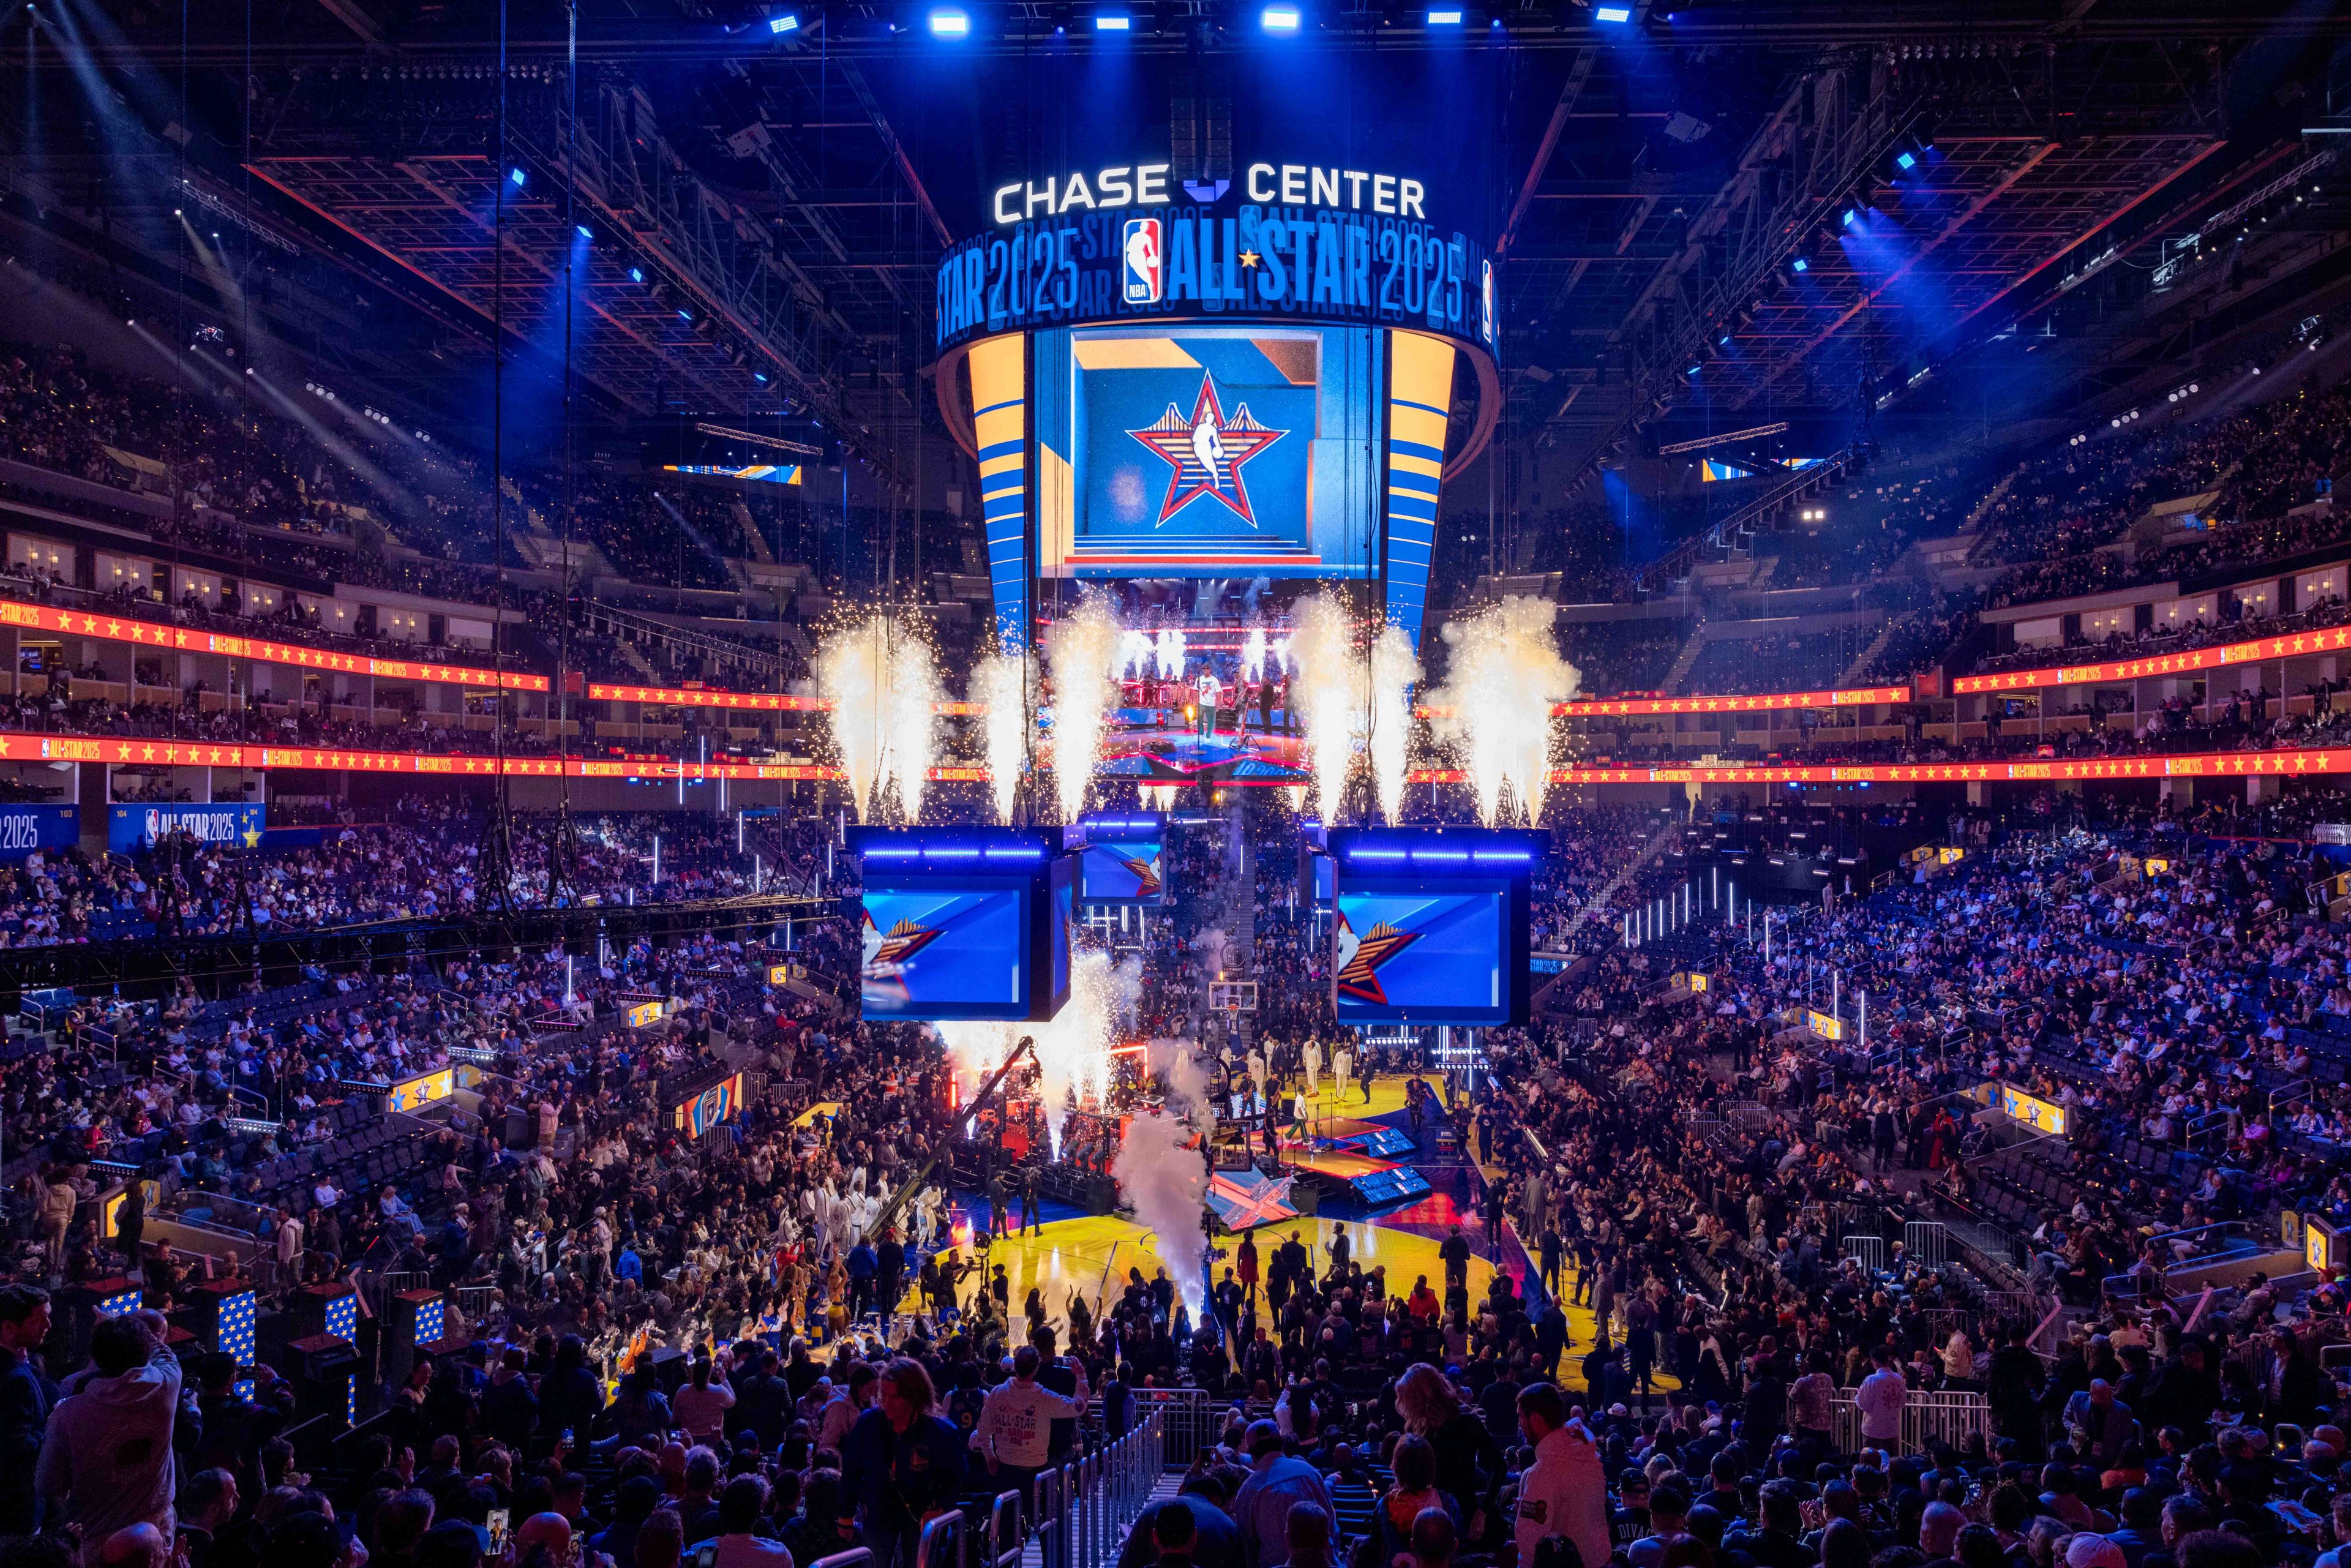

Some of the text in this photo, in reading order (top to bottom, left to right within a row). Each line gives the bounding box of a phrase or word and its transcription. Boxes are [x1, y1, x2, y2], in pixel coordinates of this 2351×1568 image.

[994, 163, 1425, 224] CHASE CENTER
[1167, 218, 1246, 300] ALL
[1258, 219, 1371, 307] STAR
[1379, 229, 1463, 323] 2025
[937, 247, 985, 345] STAR
[989, 227, 1079, 320] 2025
[1128, 283, 1148, 298] NBA
[1, 604, 21, 623] STAR
[215, 637, 223, 651] ALL
[225, 638, 238, 654] STAR
[2234, 645, 2247, 661] STAR
[381, 662, 392, 675] STAR
[2063, 669, 2072, 682] ALL
[2072, 668, 2087, 681] STAR
[1837, 692, 1847, 703] ALL
[1848, 692, 1861, 703] STAR
[50, 740, 62, 757] ALL
[64, 741, 83, 758] STAR
[268, 751, 276, 765] ALL
[277, 751, 290, 765] STAR
[427, 758, 438, 771] STAR
[596, 763, 610, 775] STAR
[774, 767, 787, 777] STAR
[1837, 768, 1846, 779] ALL
[1847, 768, 1861, 779] STAR
[2023, 765, 2037, 778] STAR
[2178, 759, 2190, 774] STAR
[1655, 770, 1663, 781] ALL
[1665, 770, 1678, 781] STAR
[4, 815, 38, 849] 2025
[182, 813, 209, 841] STAR
[210, 813, 234, 841] 2025
[1014, 1415, 1037, 1430] STAR
